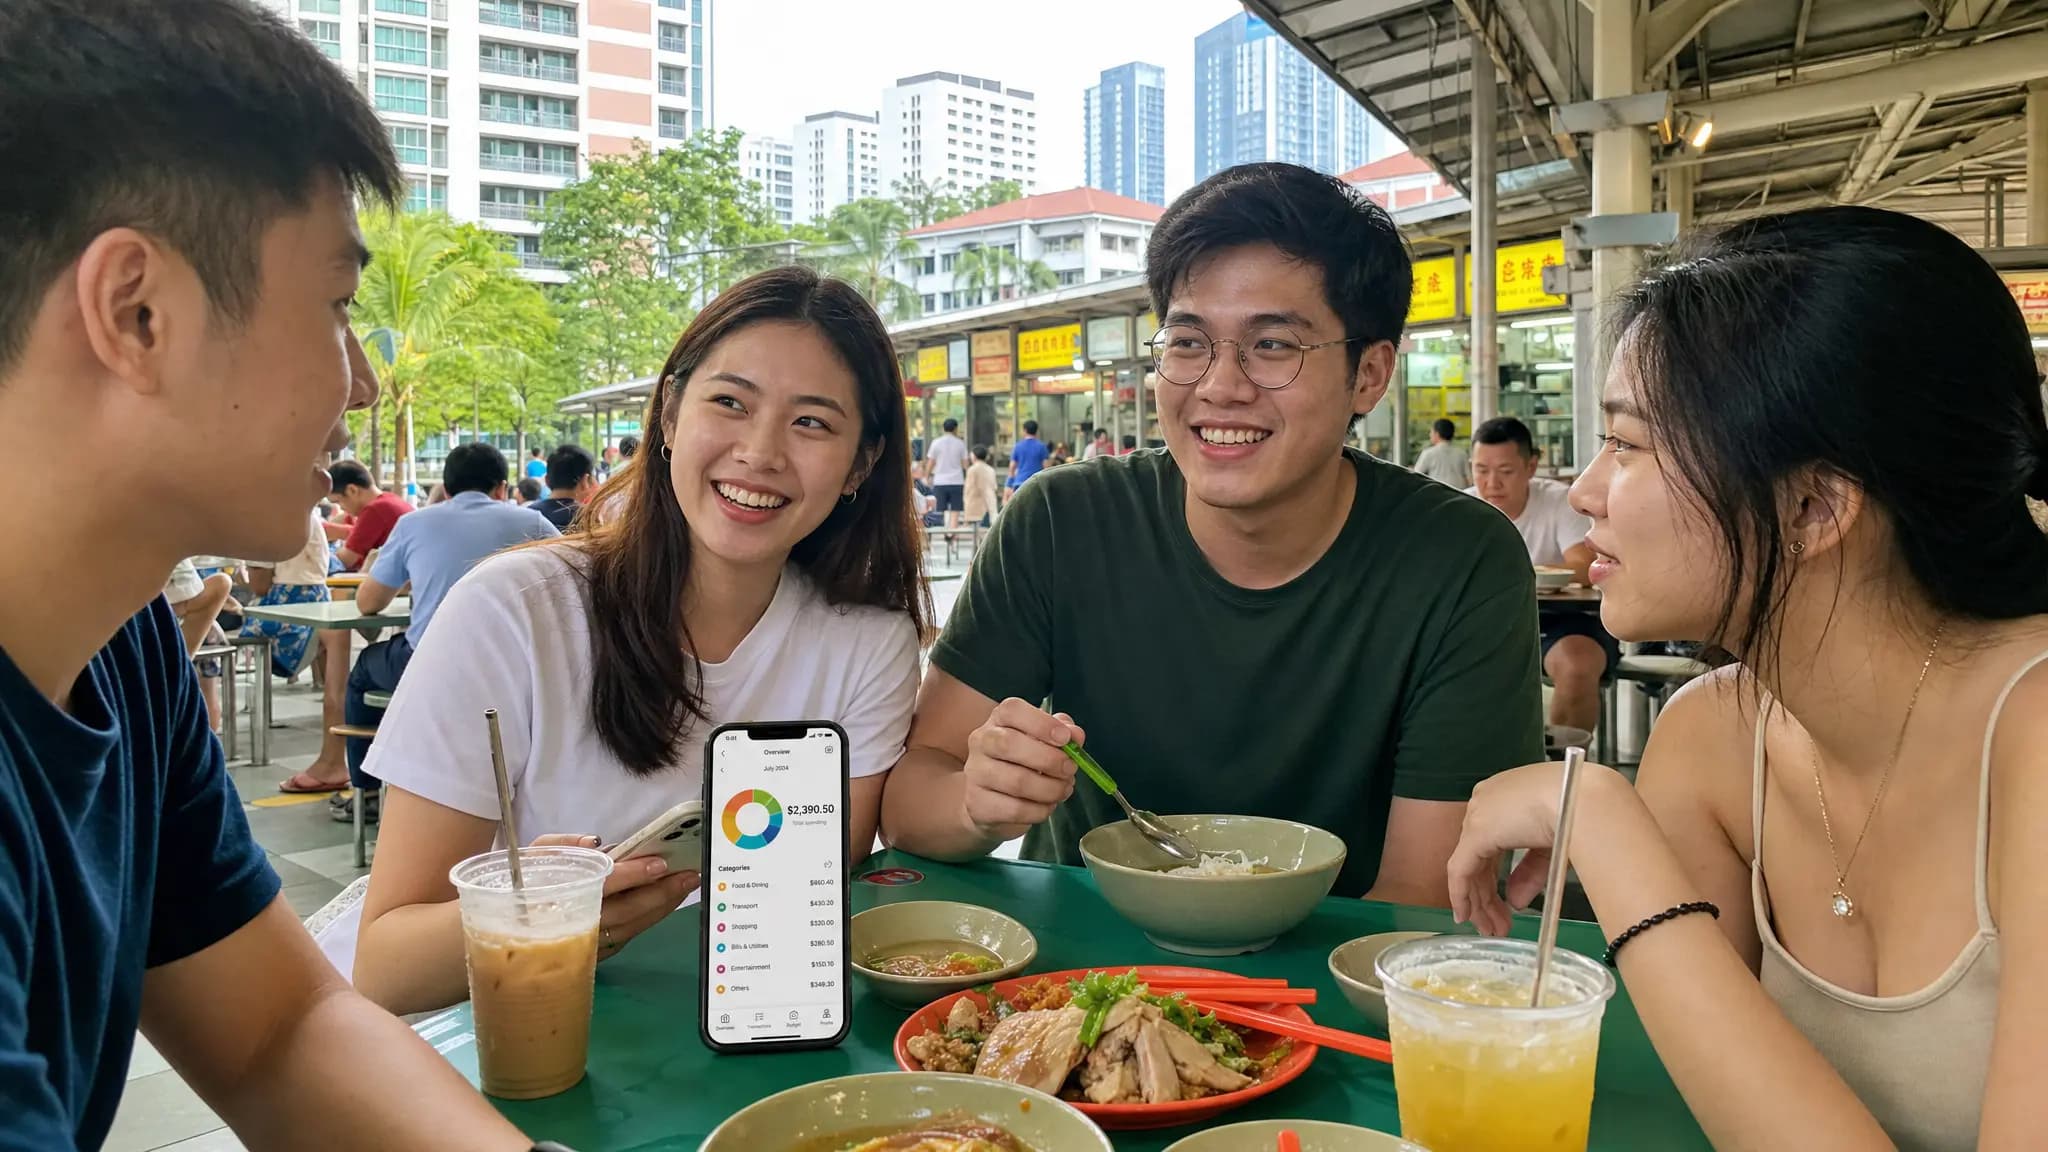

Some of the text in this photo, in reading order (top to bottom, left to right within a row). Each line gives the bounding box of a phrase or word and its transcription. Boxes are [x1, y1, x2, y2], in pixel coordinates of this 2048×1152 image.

[787, 804, 835, 816] $2,390.50
[718, 864, 750, 872] Categories
[810, 939, 834, 947] $280.50
